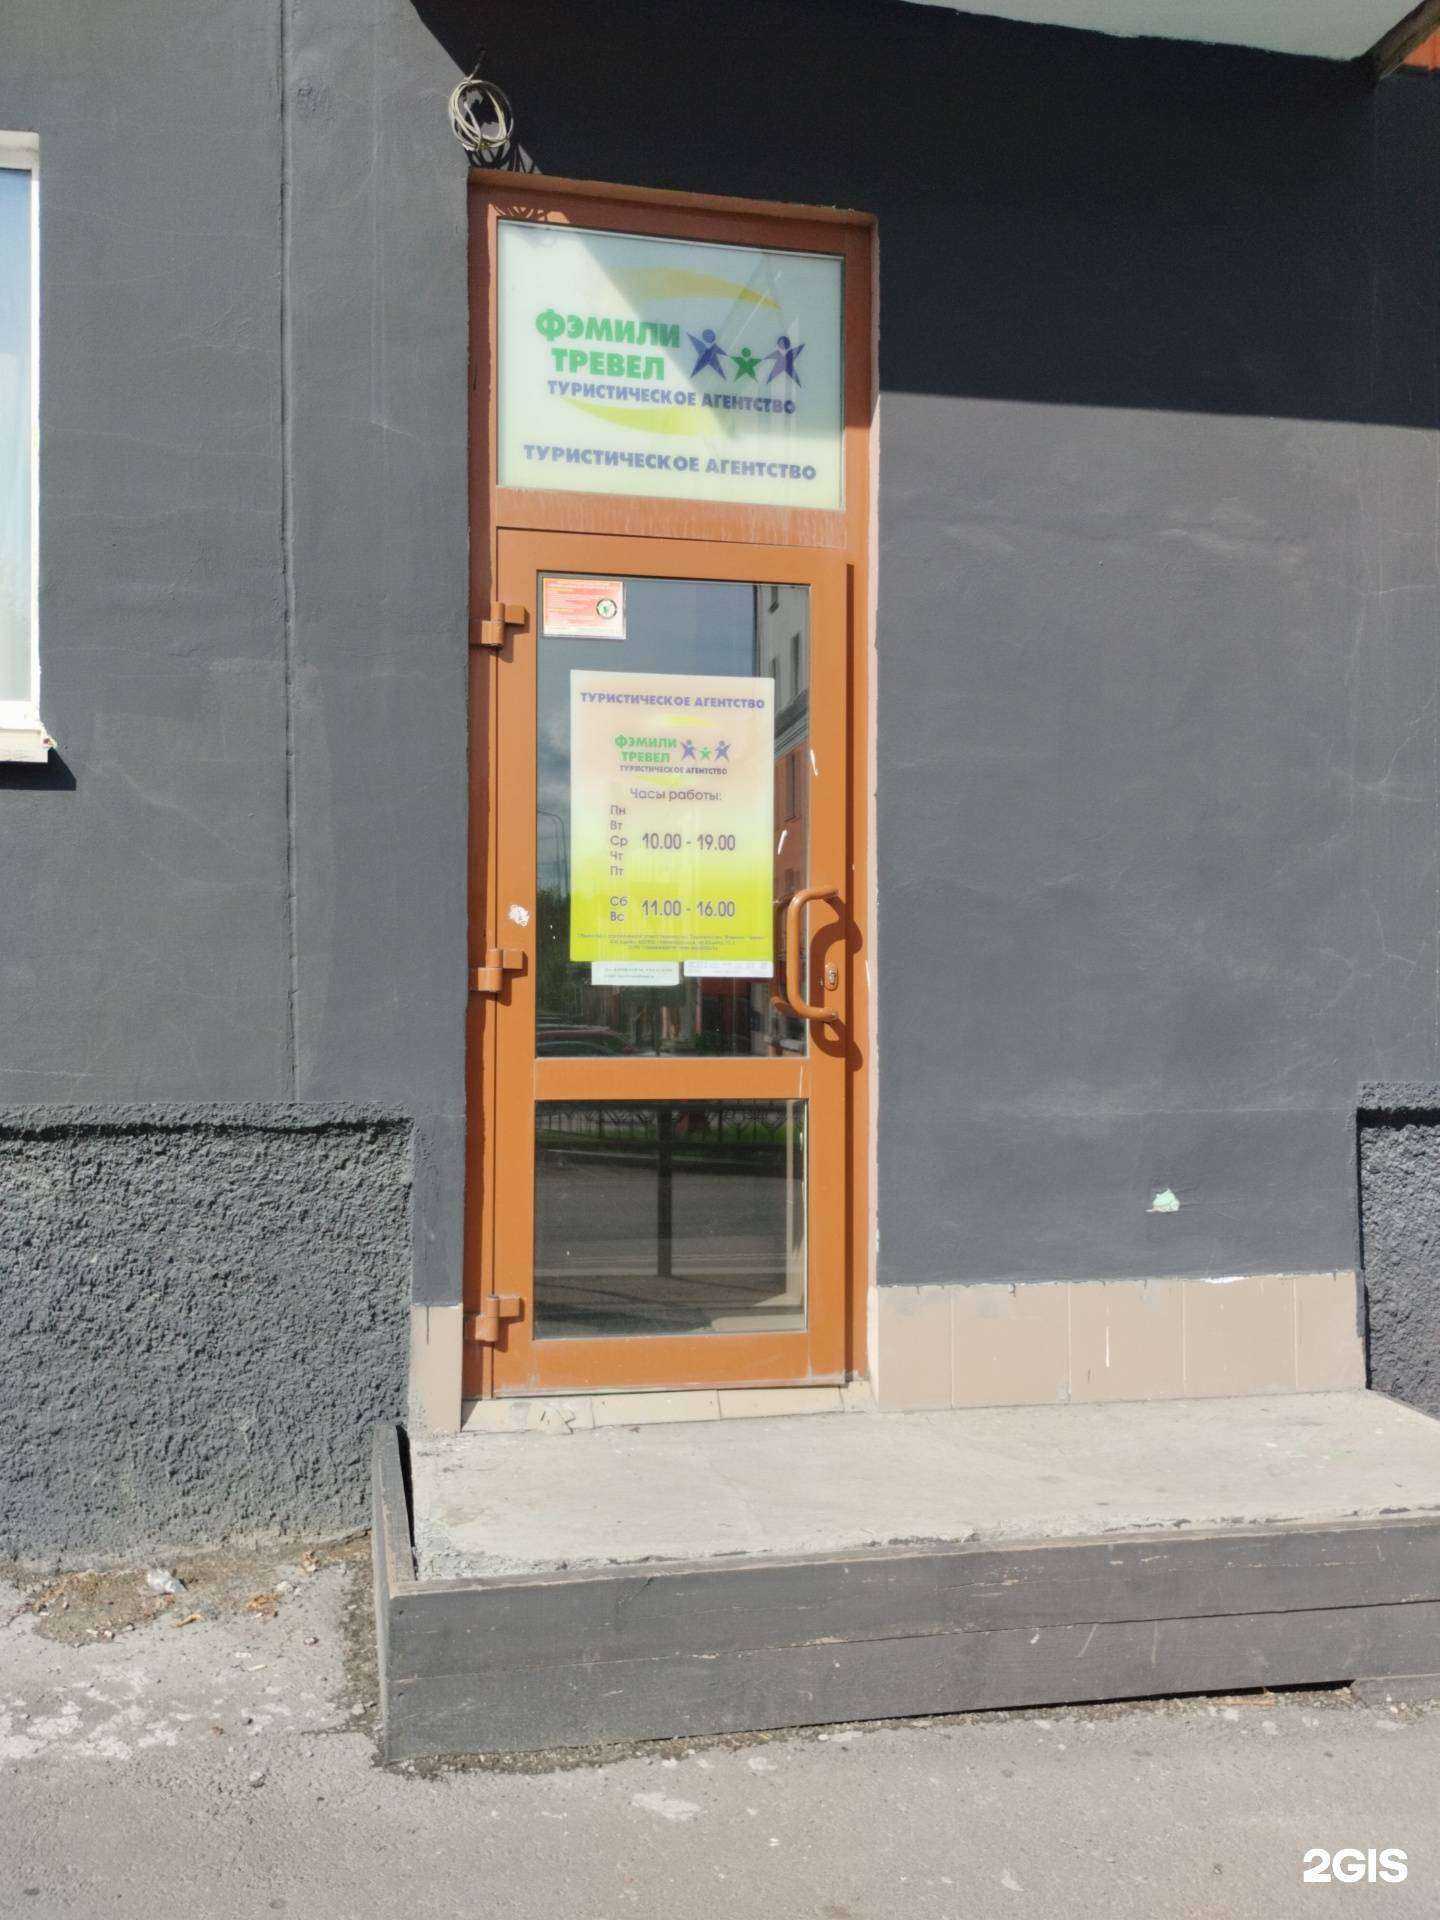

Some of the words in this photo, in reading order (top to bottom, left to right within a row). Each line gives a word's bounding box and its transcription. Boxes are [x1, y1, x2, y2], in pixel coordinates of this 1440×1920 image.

[535, 309, 680, 349] ФЭМИЛИ
[551, 348, 665, 381] ТРЕВЕЛ
[547, 380, 697, 406] ТУРИСТИЧЕСКОЕ
[701, 393, 796, 415] АГЕНТСТВО
[524, 444, 700, 472] ТУРИСТИЧЕСКОЕ
[705, 458, 817, 481] АГЕНТСТВО
[580, 691, 691, 707] ТУРИСТИЧЕСКОЕ
[694, 696, 765, 709] АГЕНТСТВО
[614, 734, 677, 749] ФЭМИЛИ
[620, 751, 671, 763] ТРЕВЕЛ
[620, 764, 684, 774] ТУРИСТИЧЕСКОЕ
[685, 767, 728, 775] АГЕНТСТВО
[630, 788, 666, 799] Часы
[668, 789, 723, 802] работы:
[610, 805, 626, 816] Пн
[610, 820, 623, 831] Вт
[609, 836, 628, 848] Ср
[641, 833, 682, 850] 10.00
[697, 834, 736, 851] 19.00
[610, 850, 623, 861] Чт
[610, 866, 624, 877] Пт
[609, 896, 628, 907] Сб
[641, 900, 682, 917] 11.00
[697, 901, 736, 917] 16.00
[610, 911, 625, 922] Вс
